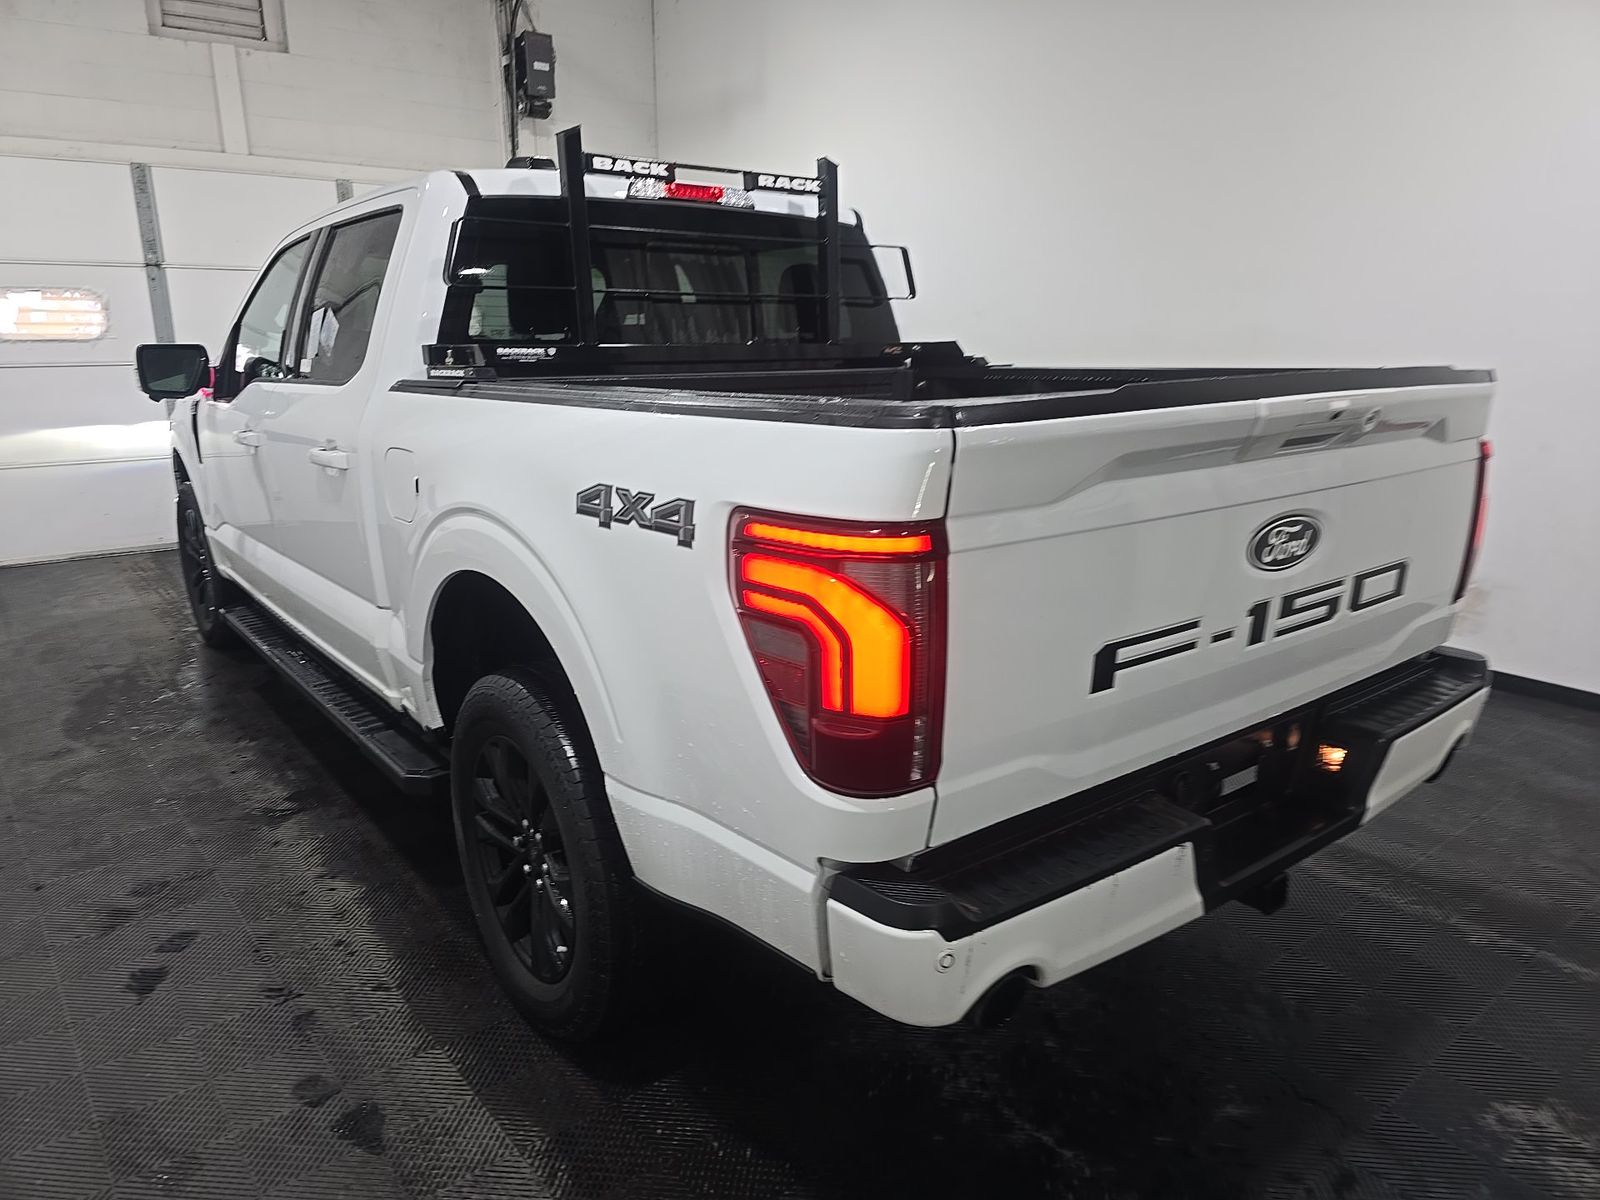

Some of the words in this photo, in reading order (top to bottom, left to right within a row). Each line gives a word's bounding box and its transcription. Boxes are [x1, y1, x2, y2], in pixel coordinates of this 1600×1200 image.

[592, 156, 670, 178] BACK
[757, 174, 822, 193] RACK
[1260, 522, 1315, 565] Ford
[1088, 558, 1409, 695] F-150
